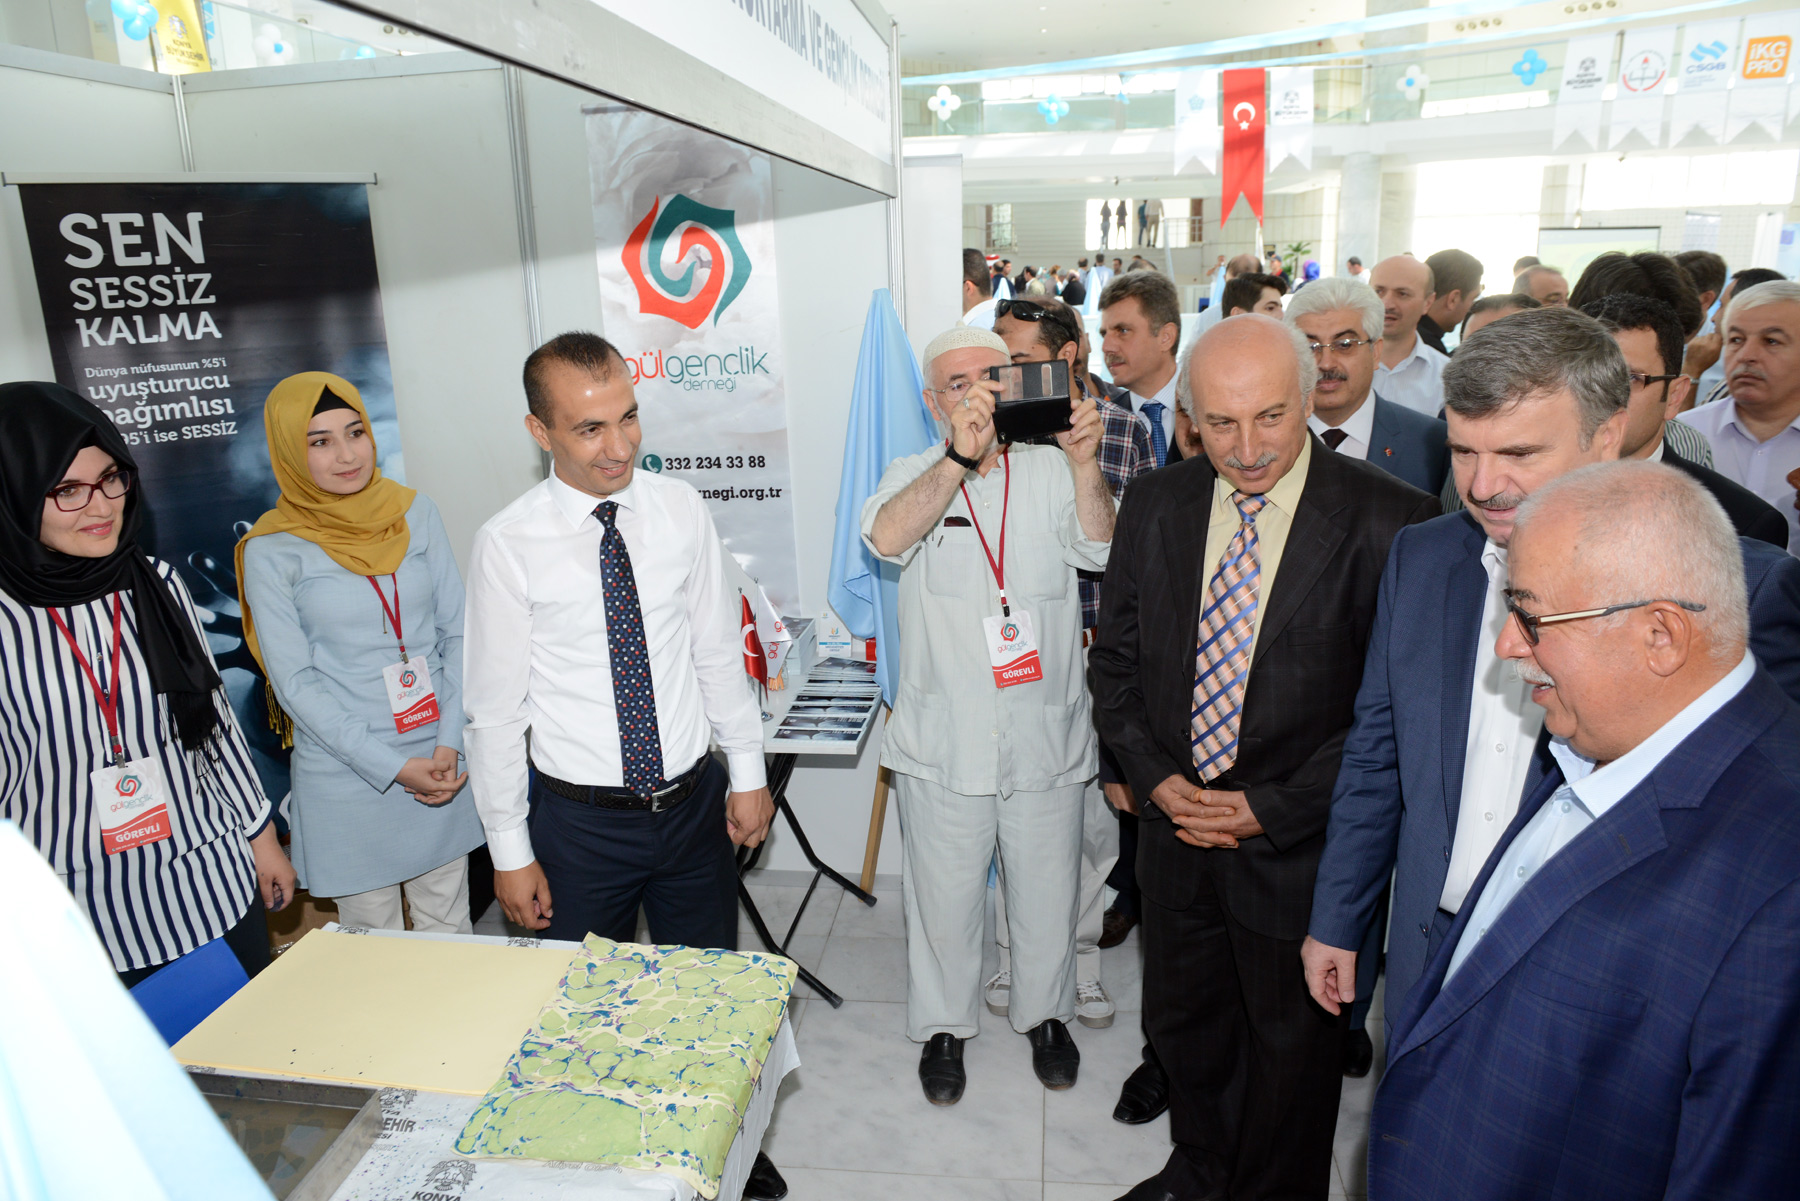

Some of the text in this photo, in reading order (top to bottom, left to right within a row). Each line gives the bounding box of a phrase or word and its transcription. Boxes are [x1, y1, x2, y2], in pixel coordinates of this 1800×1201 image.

[808, 4, 823, 73] VE
[59, 212, 206, 269] SEN
[69, 266, 216, 311] SESSİZ
[75, 311, 222, 347] KALMA
[84, 357, 227, 379] Dünya nüfusunun %5'i
[88, 375, 230, 403] uyuşturucu
[683, 377, 737, 392] derneği
[153, 430, 178, 443] ise
[181, 419, 238, 440] SESSİZ
[665, 455, 766, 470] 332 234 33 88
[698, 486, 782, 501] negi.org.tr
[1002, 665, 1035, 679] GÖREVLİ
[402, 708, 432, 724] GÖREVLİ
[115, 822, 160, 843] GÖREVLİ
